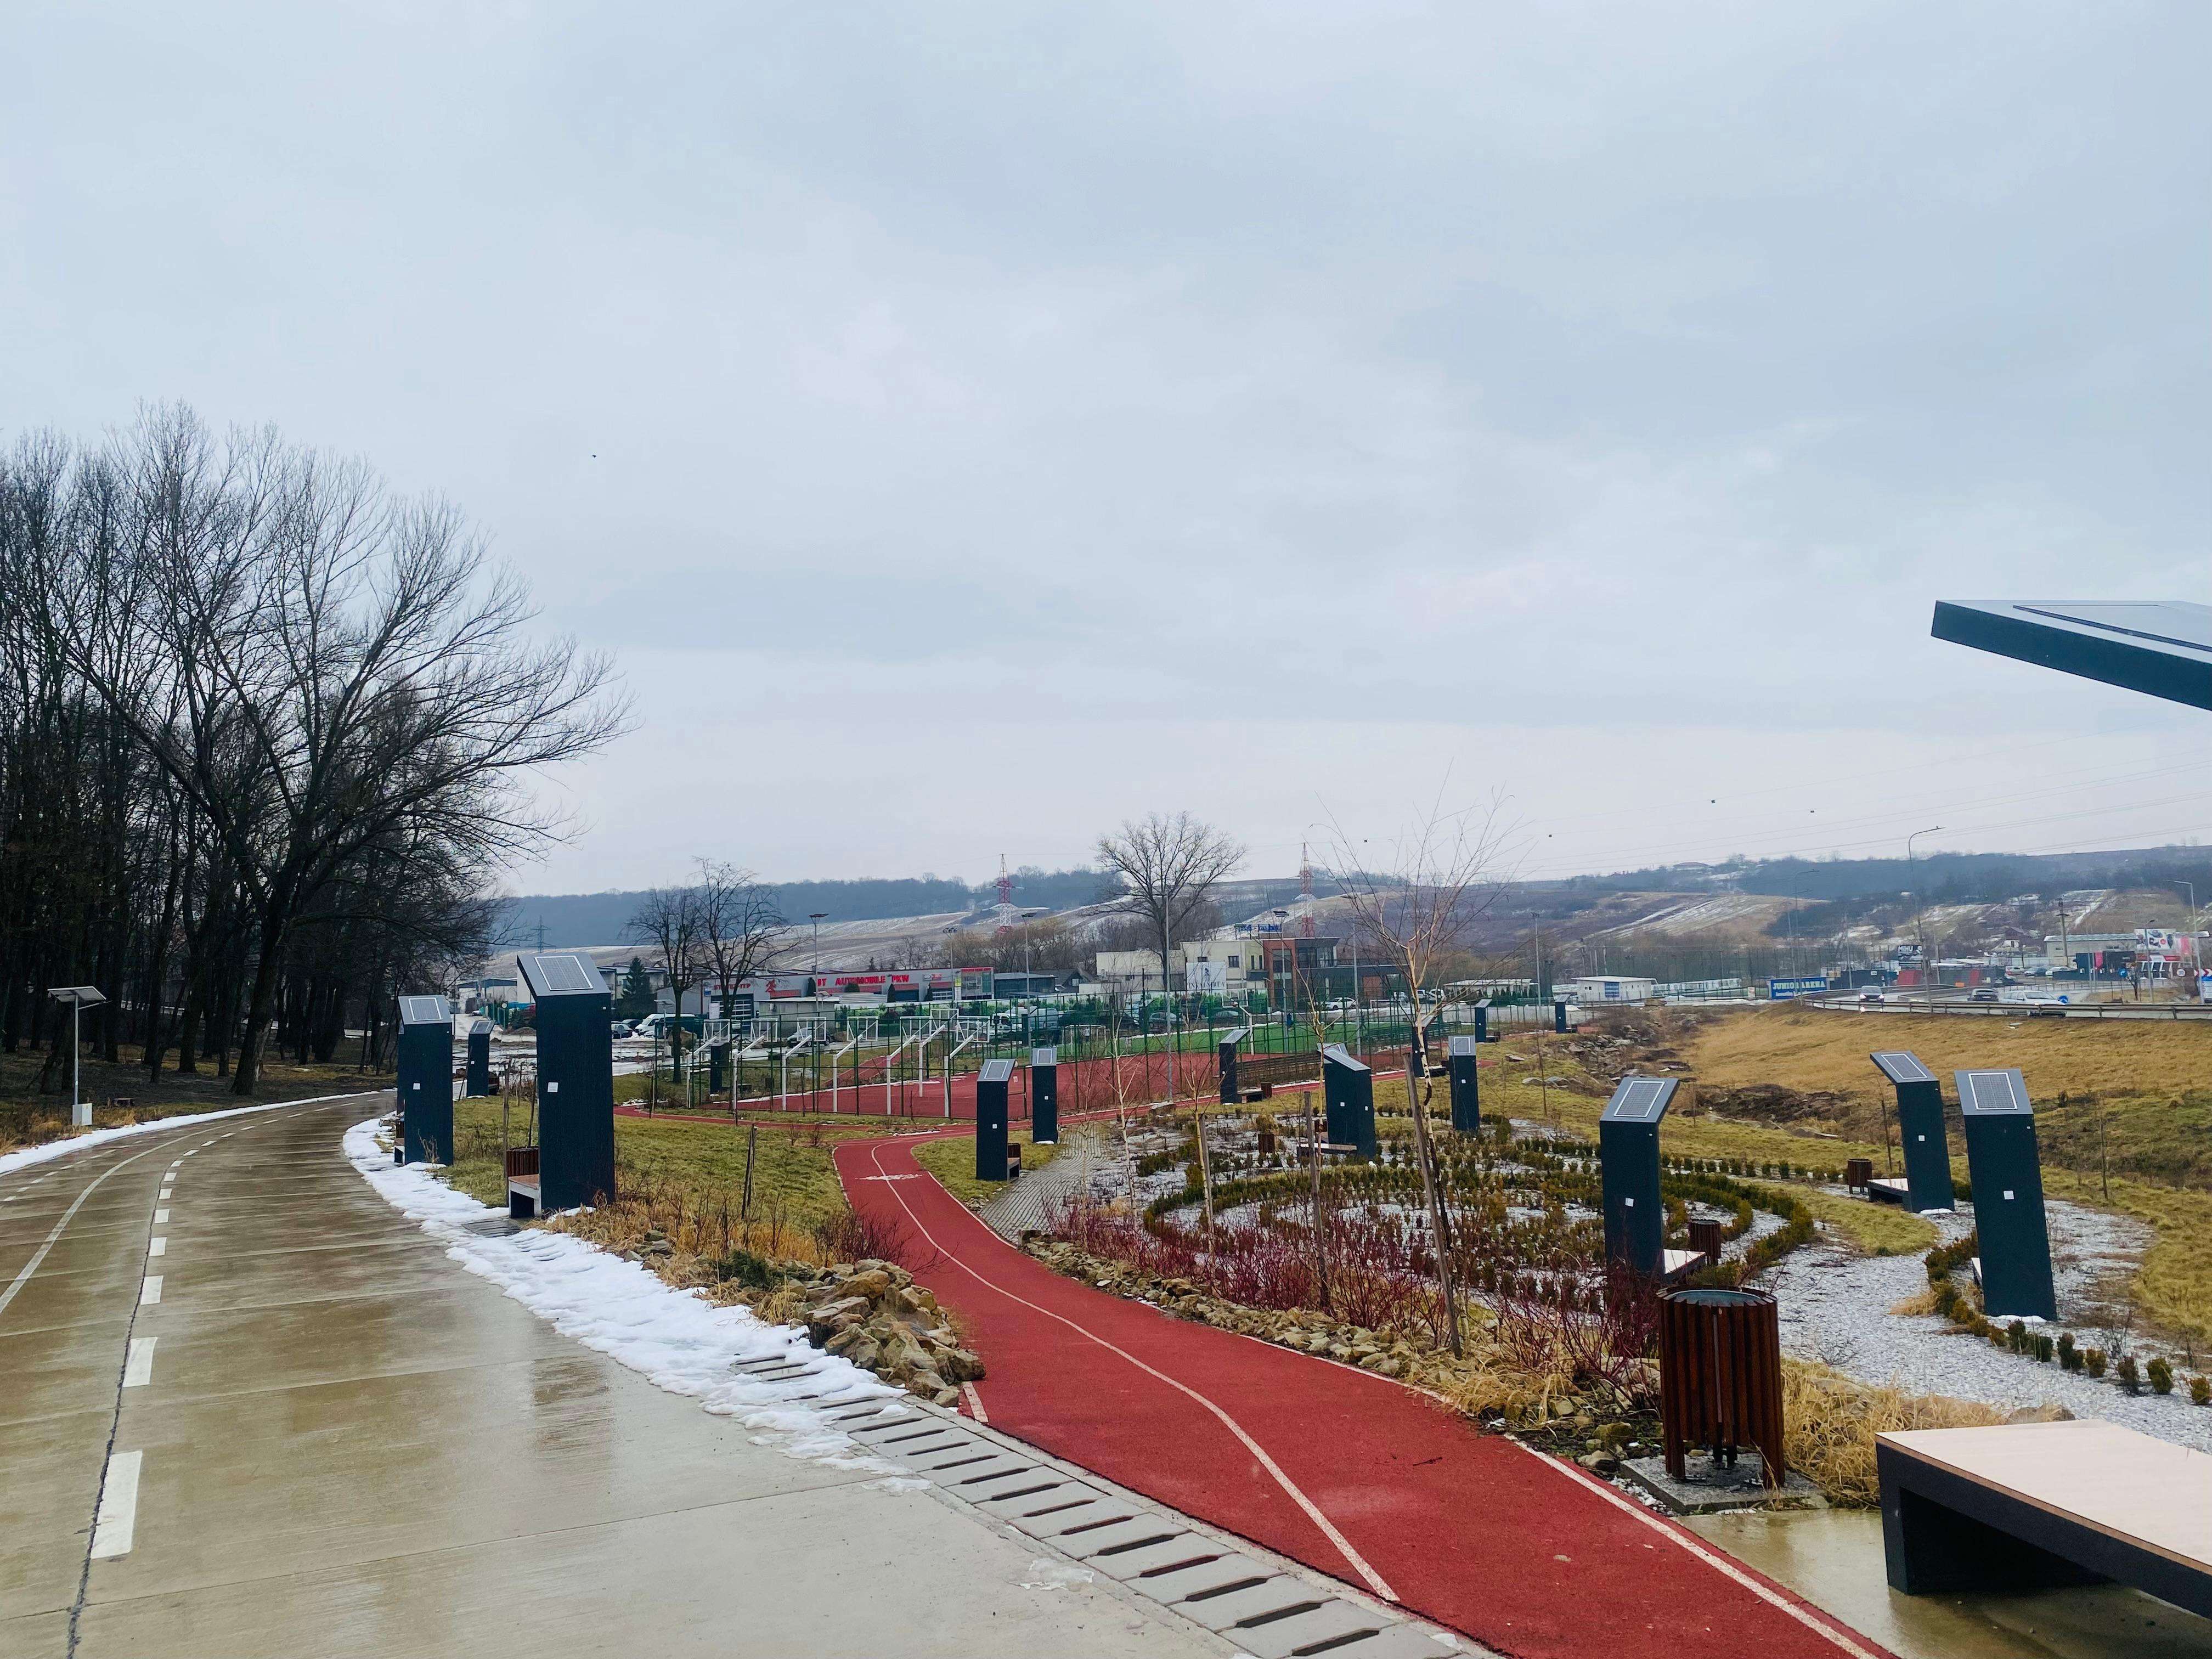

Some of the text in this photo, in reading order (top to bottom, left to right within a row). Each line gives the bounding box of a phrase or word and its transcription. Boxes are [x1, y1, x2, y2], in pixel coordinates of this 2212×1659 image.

[835, 975, 885, 986] AUTOMOBILE
[891, 974, 910, 983] PKW
[1773, 980, 1826, 990] JUNIOR ARENA
